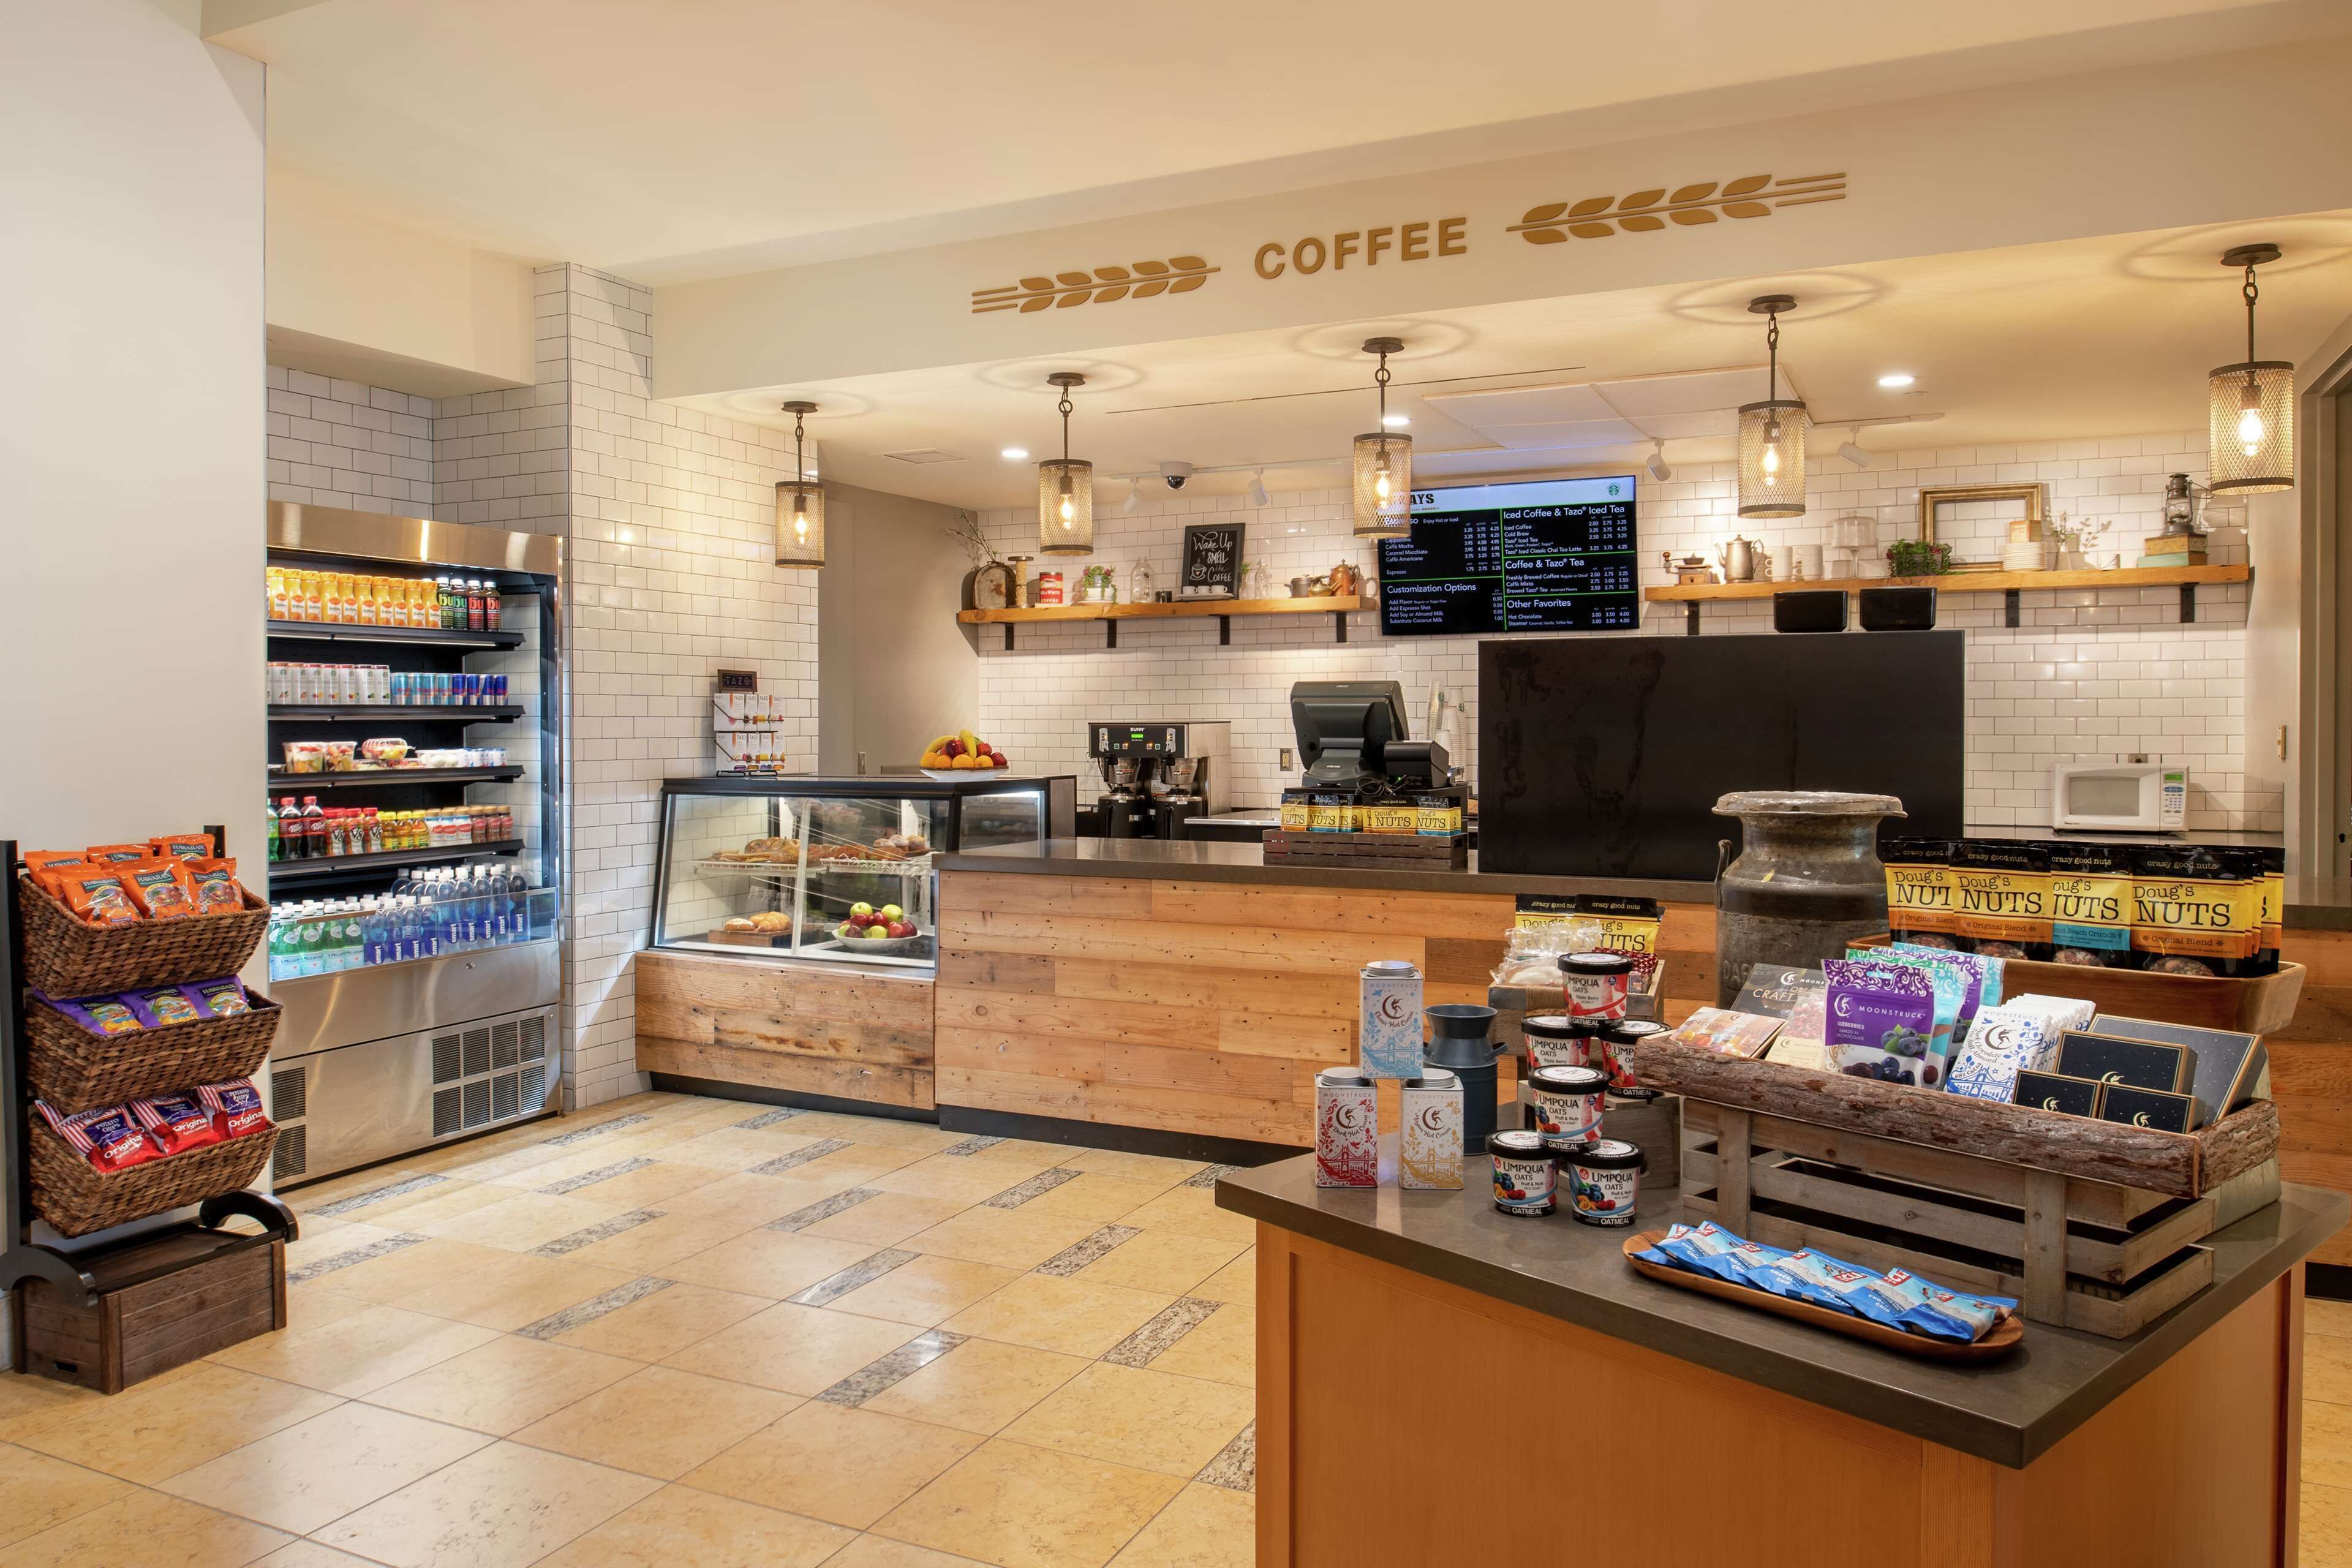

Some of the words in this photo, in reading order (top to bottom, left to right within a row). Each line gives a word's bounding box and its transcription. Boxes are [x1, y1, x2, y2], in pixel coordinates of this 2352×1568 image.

[1254, 217, 1466, 279] COFFEE
[1504, 510, 1521, 519] Iced
[1523, 508, 1552, 518] Coffee
[1589, 505, 1607, 514] Iced
[1609, 505, 1625, 513] Tea
[1193, 531, 1218, 551] Wake
[1219, 532, 1232, 551] Up
[1207, 550, 1229, 564] SMELL
[1506, 560, 1534, 569] Coffee
[1536, 559, 1543, 568] &
[1569, 558, 1585, 567] Tea
[1387, 584, 1442, 594] Customization
[1444, 584, 1477, 594] Options
[1507, 600, 1531, 608] Other
[725, 676, 750, 685] TAZO
[1308, 815, 1336, 825] NUTS
[1375, 817, 1411, 827] NUTS
[1417, 817, 1446, 828] NUTS
[350, 828, 363, 840] V8
[370, 827, 382, 839] V8
[1968, 853, 1989, 862] crazy
[2052, 856, 2073, 865] crazy
[2074, 856, 2093, 866] good
[2147, 860, 2172, 869] crazy
[2173, 861, 2194, 869] good
[137, 872, 171, 883] HAWAIIAN
[194, 870, 228, 879] HAWAIIAN
[1893, 870, 1943, 883] Doug's
[1958, 875, 2011, 890] Doug's
[2133, 884, 2195, 900] Doug's
[1961, 888, 2042, 915] NUTS
[2135, 900, 2231, 927] NUTS
[1972, 921, 2003, 930] Original
[2003, 923, 2026, 932] Blend
[2151, 935, 2184, 946] Original
[2185, 937, 2214, 947] Blend
[1752, 989, 1795, 1001] CRAFT
[1374, 1011, 1388, 1026] Classic
[1401, 1011, 1414, 1026] Cocoa
[1858, 1006, 1922, 1019] MOONSTRUCK
[1985, 1011, 2038, 1020] MOONSTRUCK
[1572, 1017, 1599, 1026] OATMEAL
[1974, 1026, 1985, 1041] Dark
[1531, 1038, 1568, 1051] UMPQUA
[1975, 1040, 2002, 1058] Chocolate
[1973, 1050, 1998, 1063] Almond
[1539, 1094, 1579, 1109] UMPQUA
[96, 1118, 119, 1131] POTATO
[102, 1123, 121, 1133] CHIPS
[1333, 1126, 1348, 1137] Dark
[1359, 1115, 1368, 1132] Cocoa
[1435, 1127, 1451, 1139] Cocoa
[1548, 1141, 1578, 1150] OATMEAL
[1503, 1161, 1544, 1174] UMPQUA
[1592, 1172, 1633, 1183] UMPQUA
